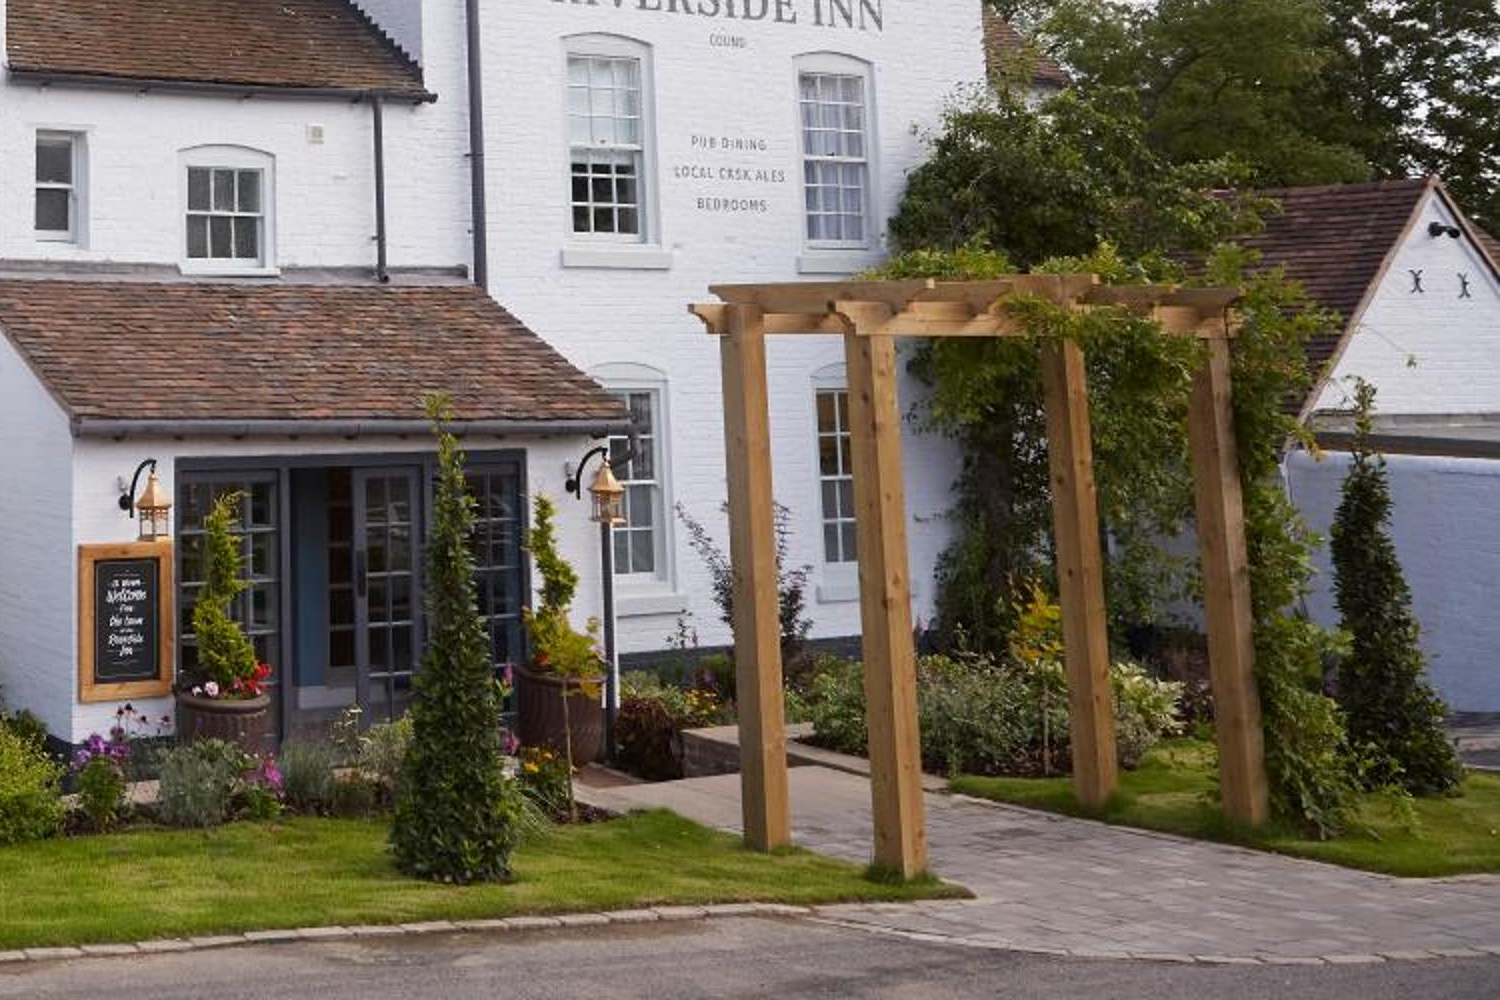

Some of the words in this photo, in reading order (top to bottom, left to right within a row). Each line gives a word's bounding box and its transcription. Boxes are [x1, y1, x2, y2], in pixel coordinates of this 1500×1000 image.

[721, 136, 767, 151] DINING
[674, 165, 714, 180] LOCAL
[719, 167, 752, 181] CASK
[755, 168, 785, 183] ALES
[696, 197, 767, 212] BEDROOMS
